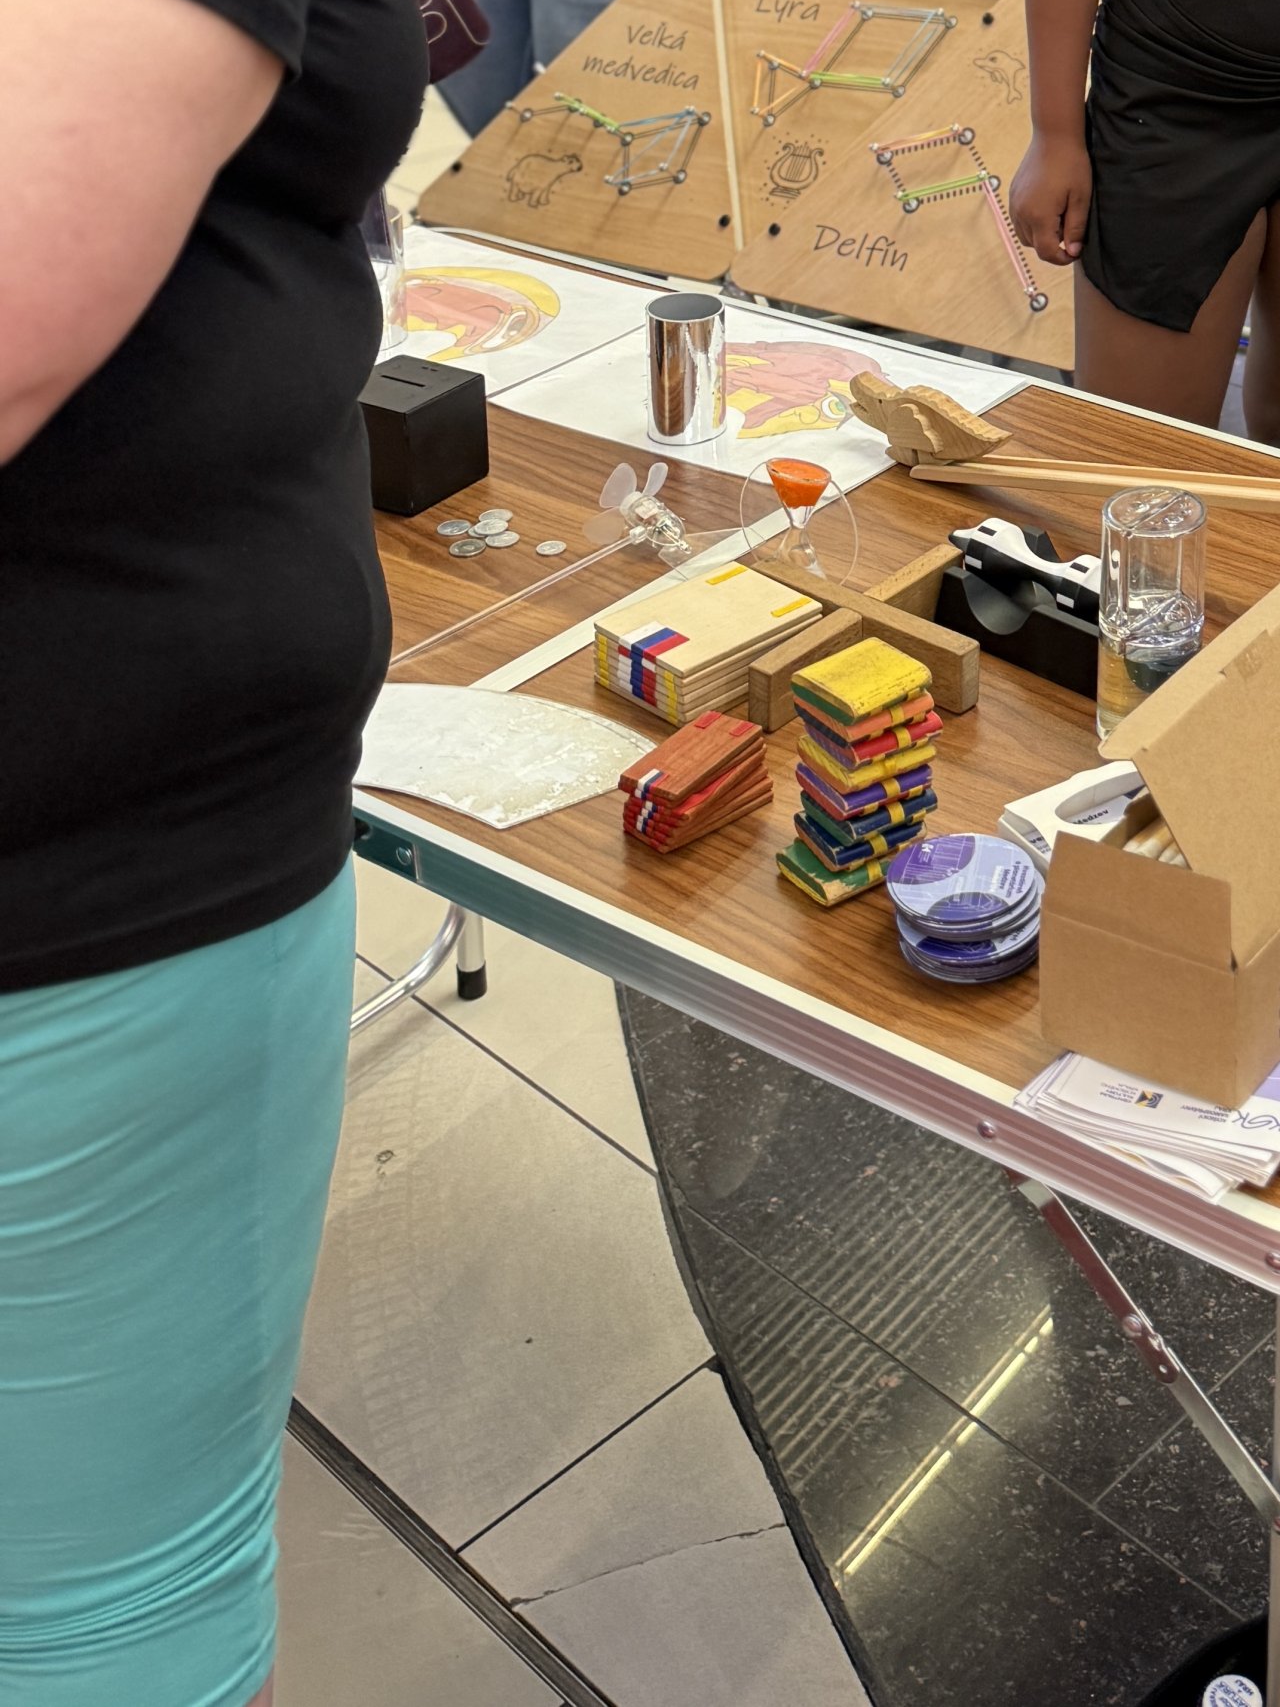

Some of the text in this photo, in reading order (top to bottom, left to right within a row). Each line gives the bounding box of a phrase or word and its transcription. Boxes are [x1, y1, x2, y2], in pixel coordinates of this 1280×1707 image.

[627, 22, 689, 51] Veľká
[582, 54, 700, 91] medvedica
[813, 224, 908, 272] Delfín
